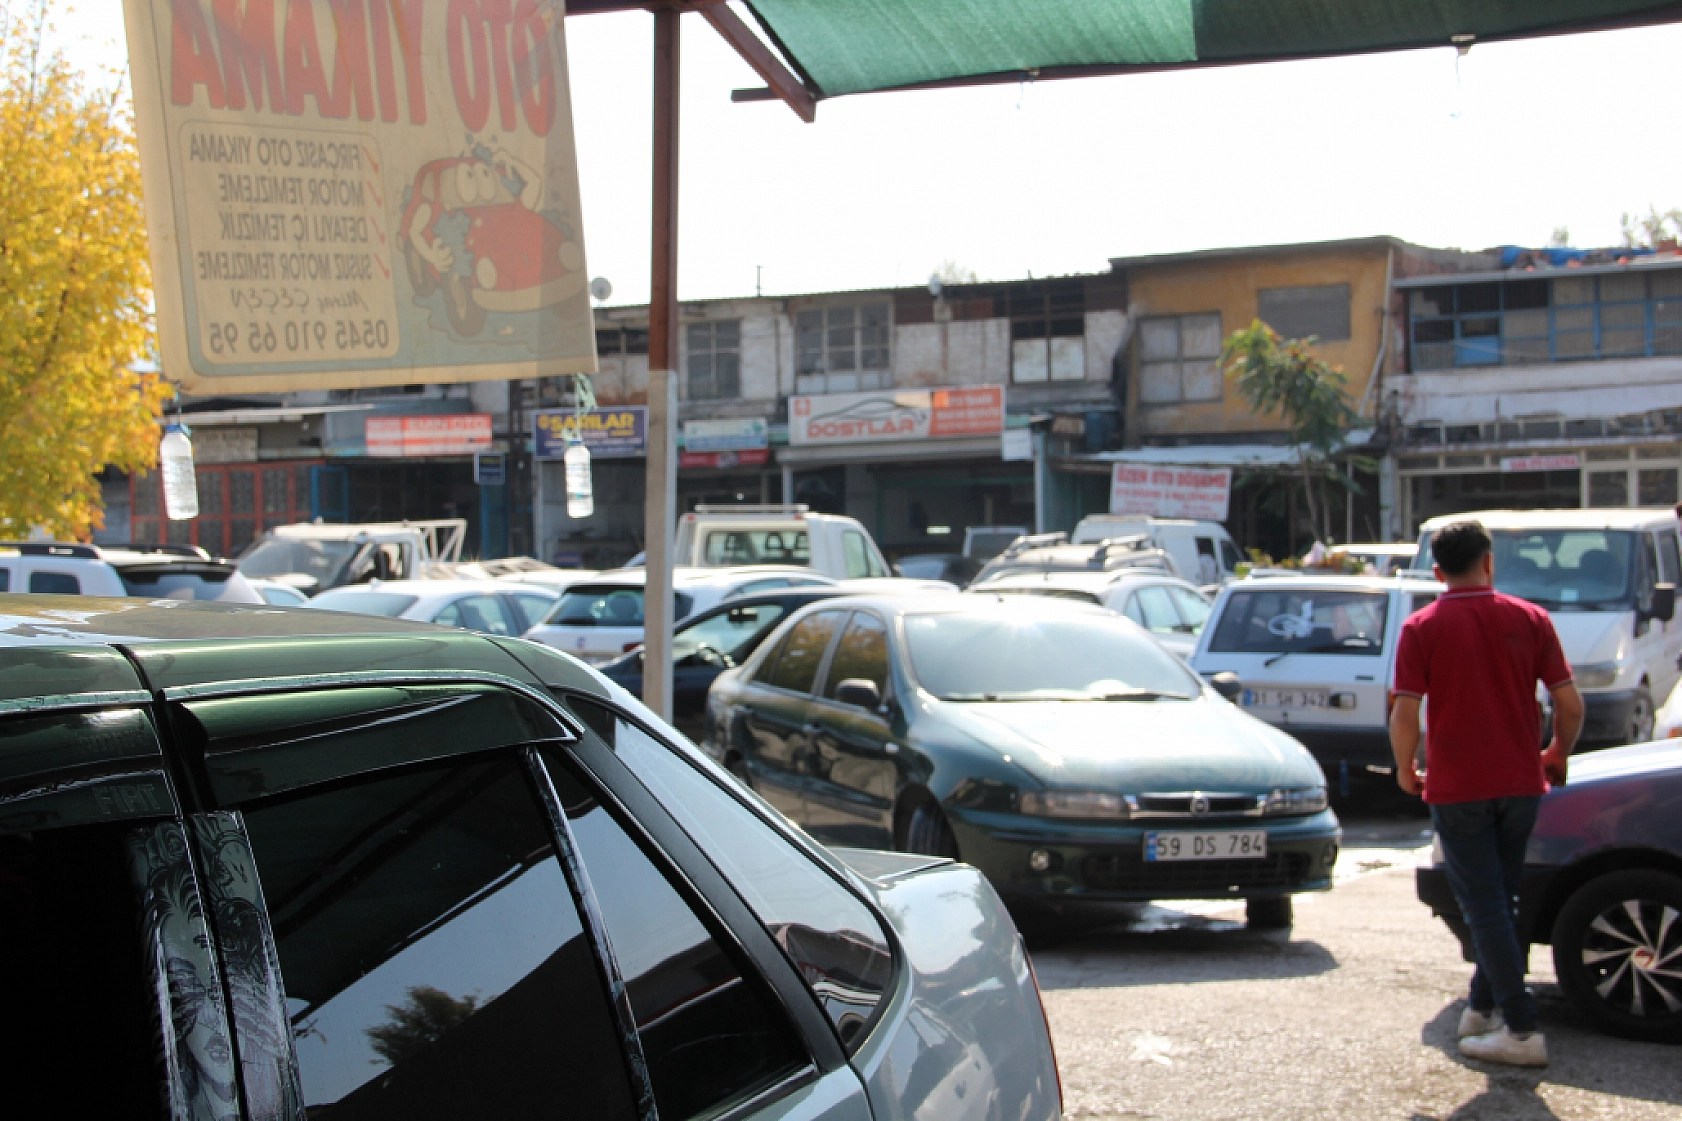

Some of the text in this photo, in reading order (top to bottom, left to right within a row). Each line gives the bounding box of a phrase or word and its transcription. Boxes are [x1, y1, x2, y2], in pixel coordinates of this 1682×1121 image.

[807, 418, 915, 438] DOSTLAR
[92, 784, 160, 815] FIAT
[1156, 834, 1263, 856] 59 DS 784
